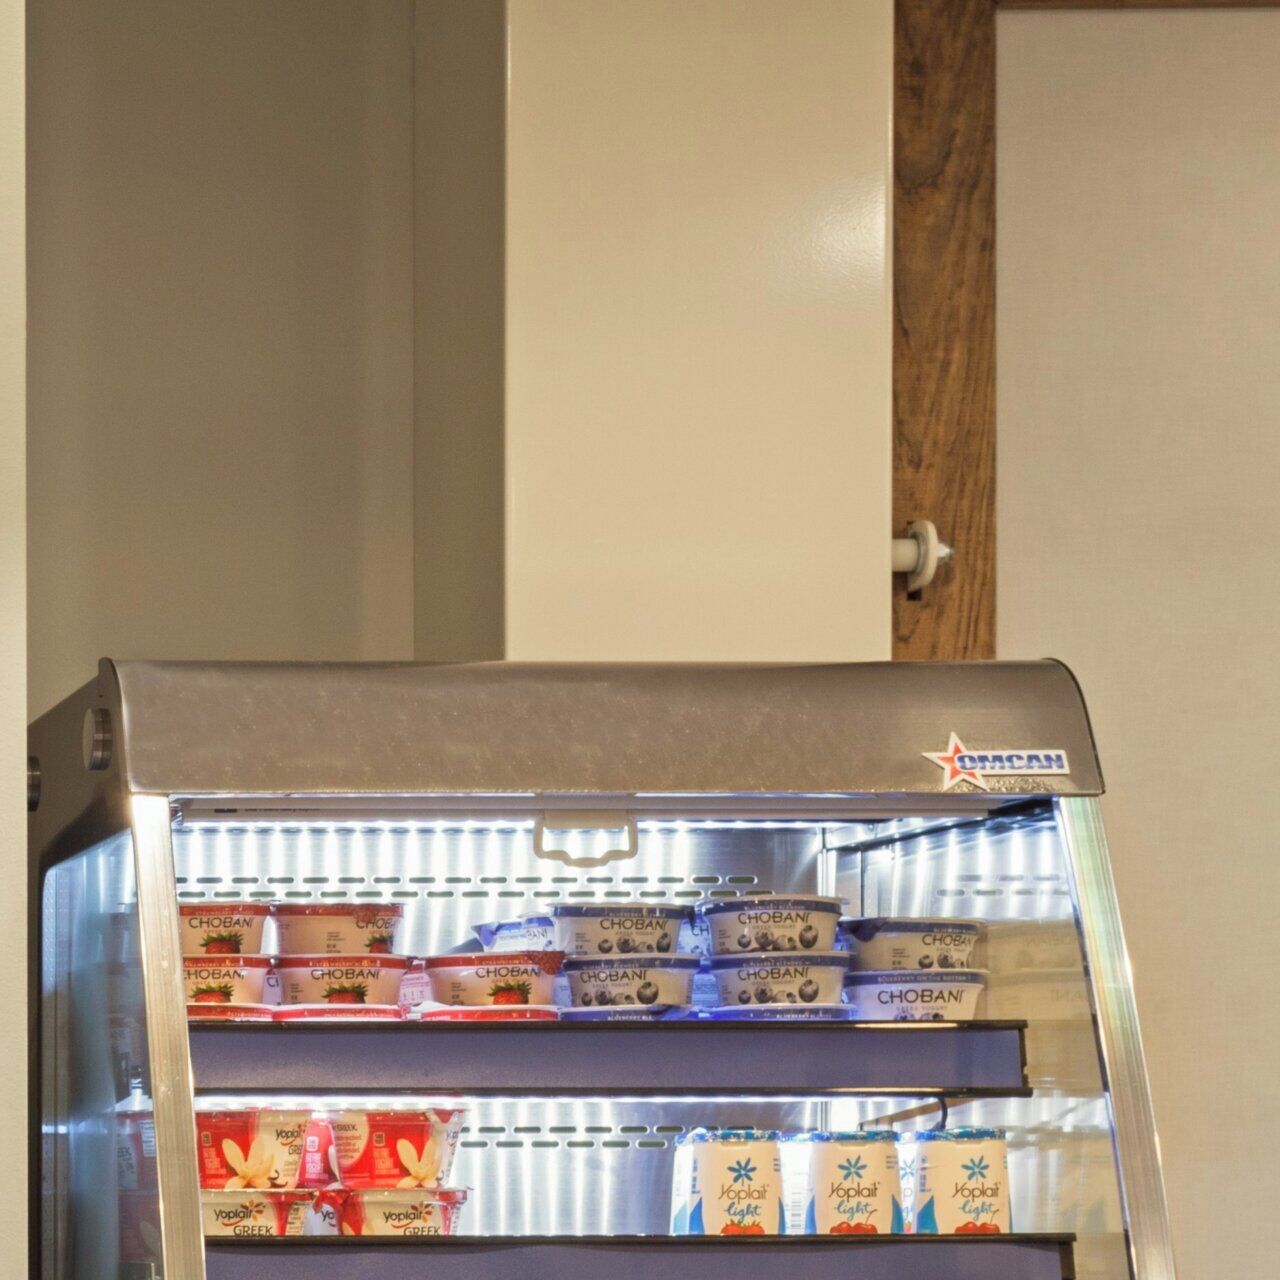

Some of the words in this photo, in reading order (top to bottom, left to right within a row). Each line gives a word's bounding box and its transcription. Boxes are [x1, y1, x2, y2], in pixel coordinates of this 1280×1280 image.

[956, 753, 1065, 771] OMCAN
[188, 916, 255, 929] CHOBANI
[599, 918, 669, 931] CHOBANI
[737, 911, 811, 925] CHOBANI
[310, 968, 381, 981] CHOBANI
[579, 969, 648, 983] CHOBANI
[736, 966, 809, 980] CHOBANI
[877, 988, 965, 1005] CHOBANI
[718, 1183, 768, 1204] Yoplait
[828, 1182, 878, 1203] Yoplait
[952, 1182, 1000, 1203] Yoplait
[213, 1208, 254, 1221] Yoplait
[383, 1210, 423, 1223] Yoplait
[725, 1201, 762, 1223] light
[834, 1200, 871, 1222] light
[959, 1200, 993, 1222] light
[233, 1225, 273, 1236] GREEK
[403, 1226, 441, 1236] GREEK
